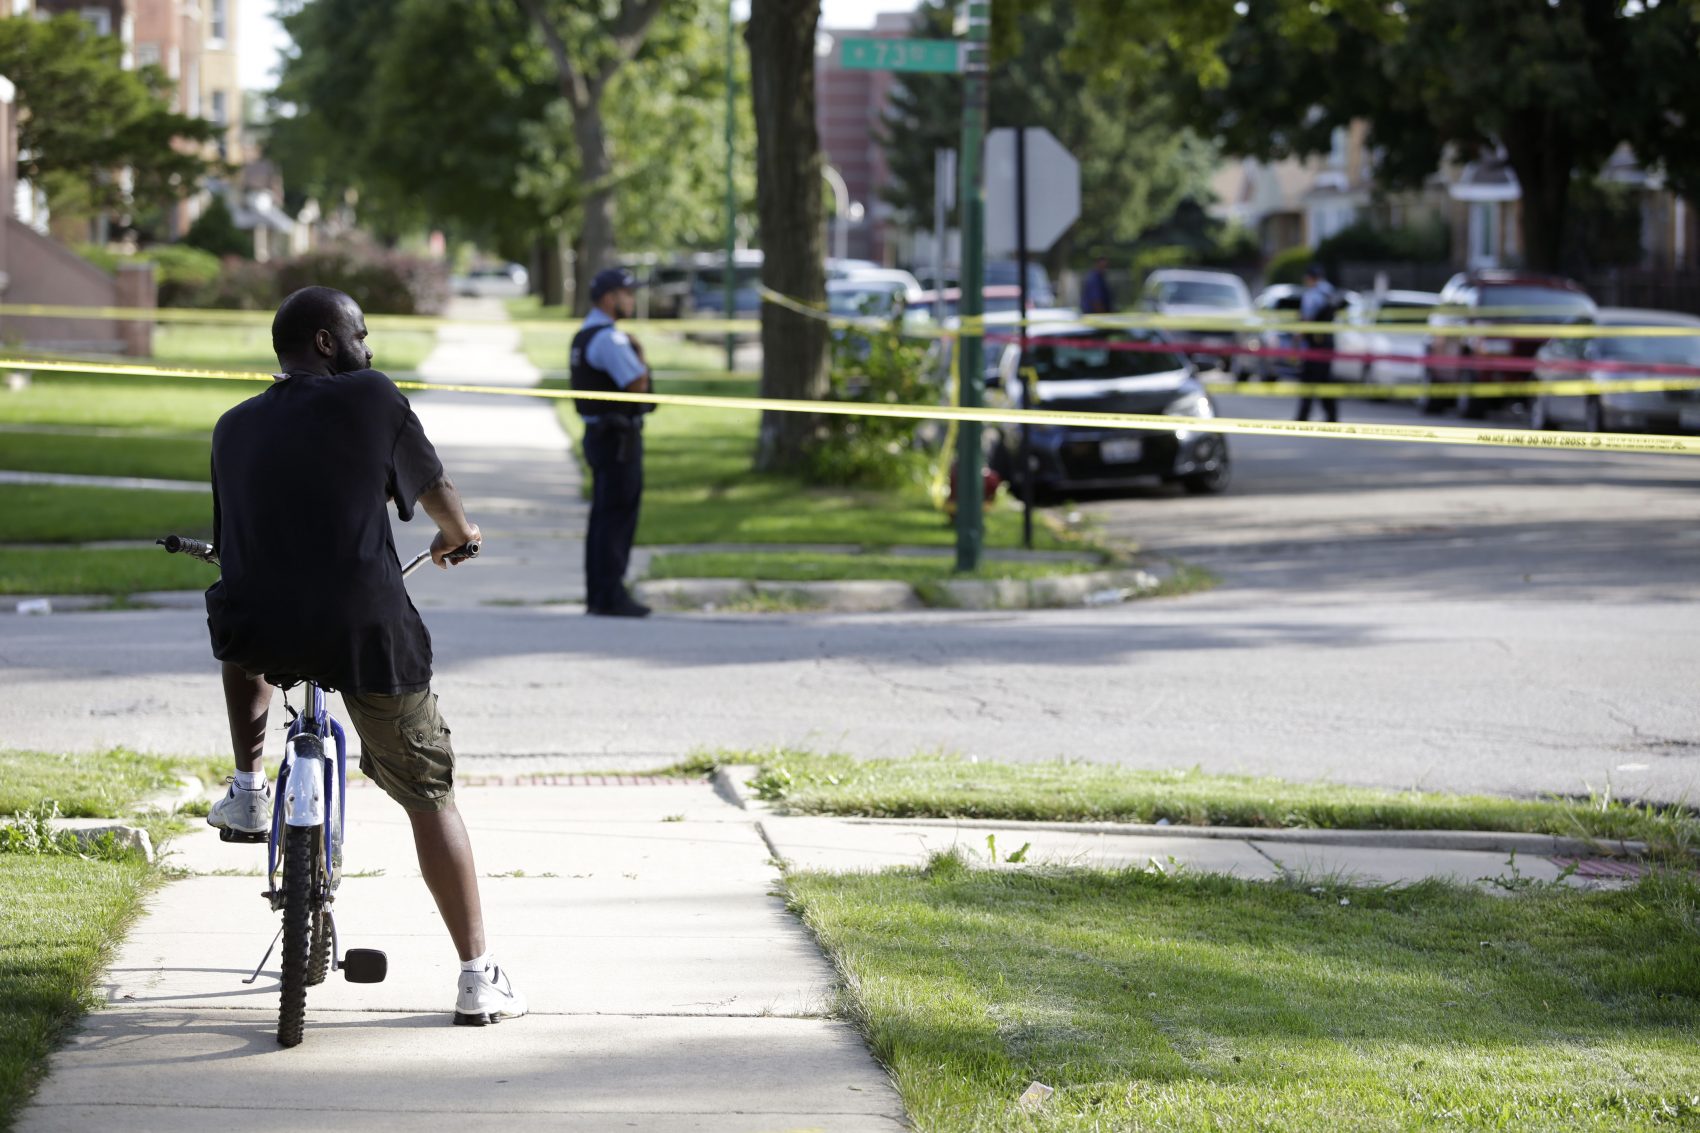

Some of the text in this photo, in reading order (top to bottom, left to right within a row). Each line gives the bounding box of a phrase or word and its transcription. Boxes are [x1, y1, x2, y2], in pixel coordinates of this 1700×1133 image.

[1477, 434, 1586, 447] POLICE LINE DO NOT CROSS
